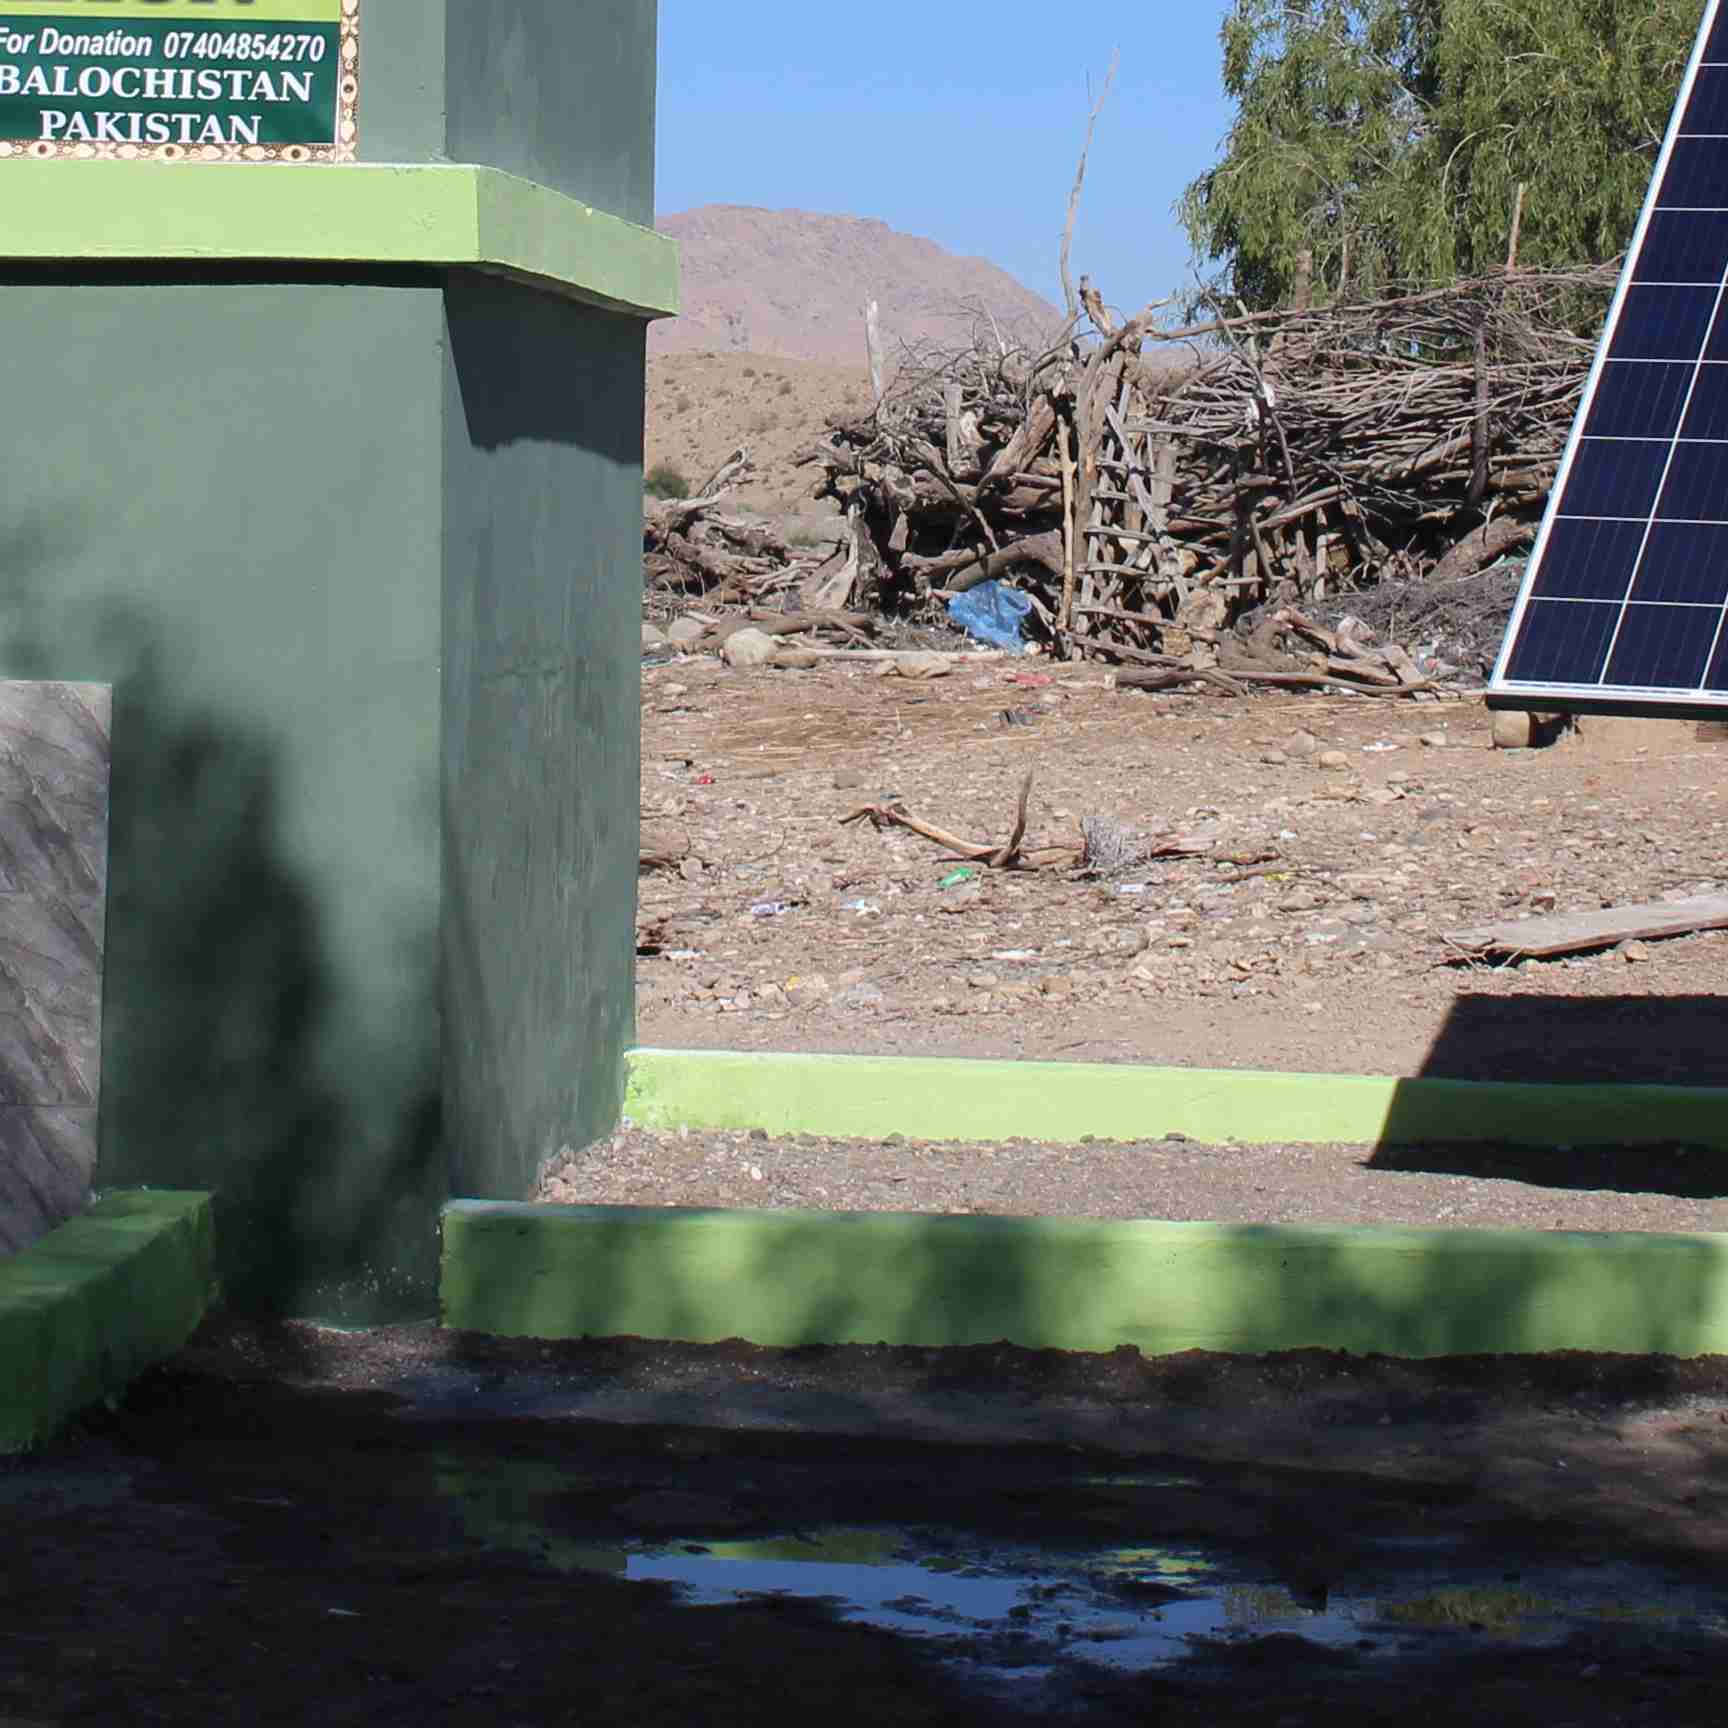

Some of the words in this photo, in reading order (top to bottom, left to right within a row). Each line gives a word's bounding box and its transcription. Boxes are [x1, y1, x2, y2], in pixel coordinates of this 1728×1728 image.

[39, 28, 152, 57] Donation
[164, 32, 326, 61] 07404854270
[39, 110, 261, 144] PAKISTAN
